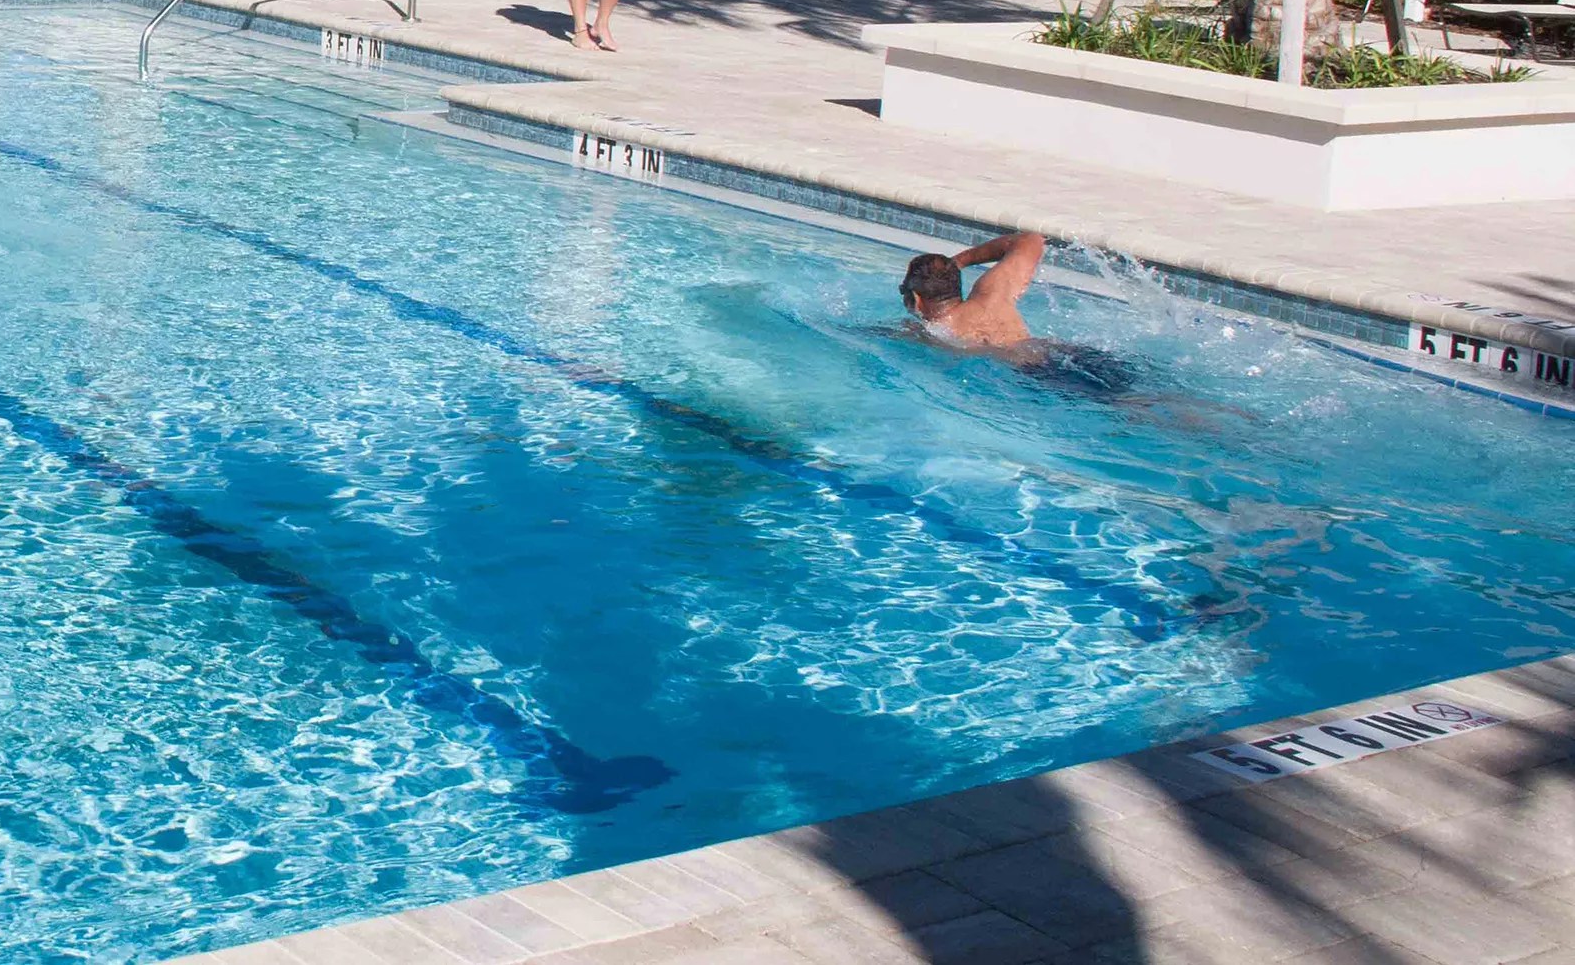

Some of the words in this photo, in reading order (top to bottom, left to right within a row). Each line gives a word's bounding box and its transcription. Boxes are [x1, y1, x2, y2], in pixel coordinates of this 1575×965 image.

[326, 30, 332, 49] 3
[338, 32, 352, 52] FT
[357, 36, 363, 56] 6
[369, 38, 382, 59] IN
[579, 133, 588, 156] 4
[596, 137, 617, 162] FT
[623, 144, 633, 167] 3
[642, 147, 660, 173] IN
[1420, 326, 1436, 355] 5
[1450, 333, 1488, 363] FT
[1500, 346, 1519, 373] 6
[1535, 352, 1570, 386] IN
[1210, 748, 1281, 775] 5
[1248, 733, 1344, 766] FT
[1318, 725, 1385, 750] 6
[1354, 711, 1449, 741] IN
